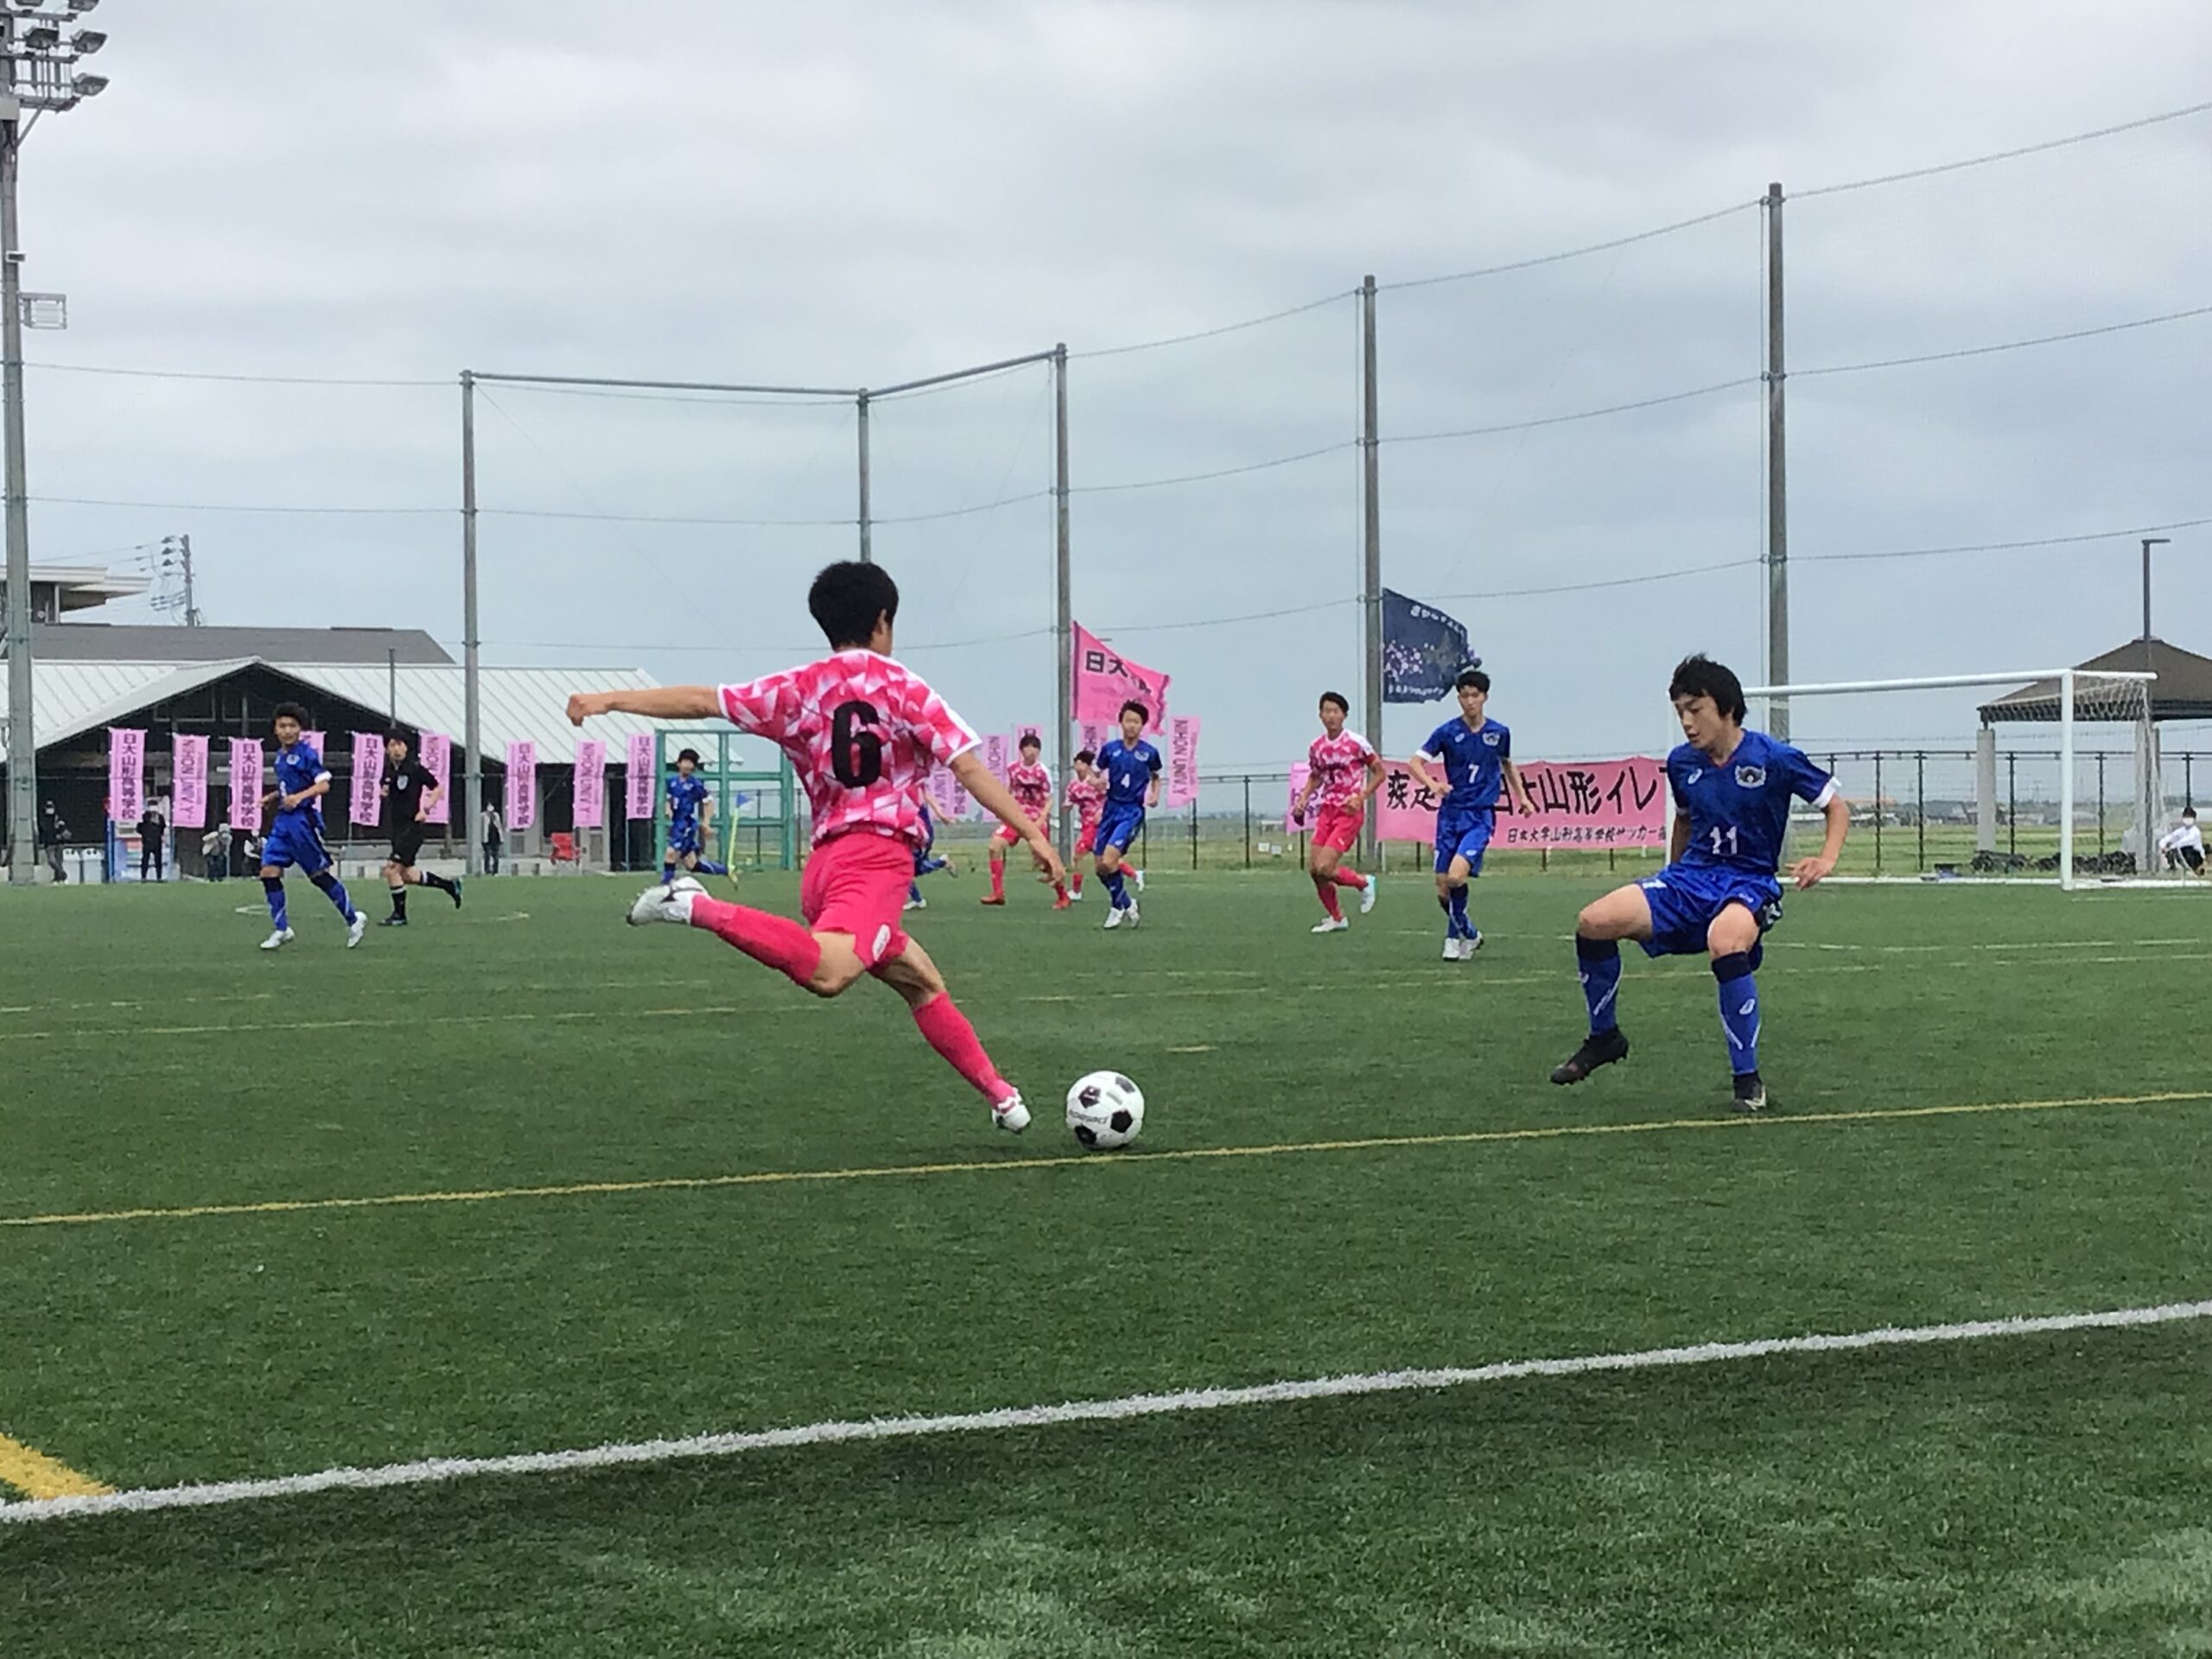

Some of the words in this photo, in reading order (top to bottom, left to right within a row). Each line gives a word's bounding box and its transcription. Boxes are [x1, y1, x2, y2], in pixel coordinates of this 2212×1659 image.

[831, 701, 881, 789] 6
[1173, 720, 1188, 754] NIHON
[181, 739, 195, 774] NIHON
[1469, 764, 1479, 783] 7
[122, 734, 137, 819] 日大山形高等学校
[241, 743, 256, 827] 日大山形高等学校
[1122, 773, 1130, 788] 4
[1710, 826, 1738, 855] 11
